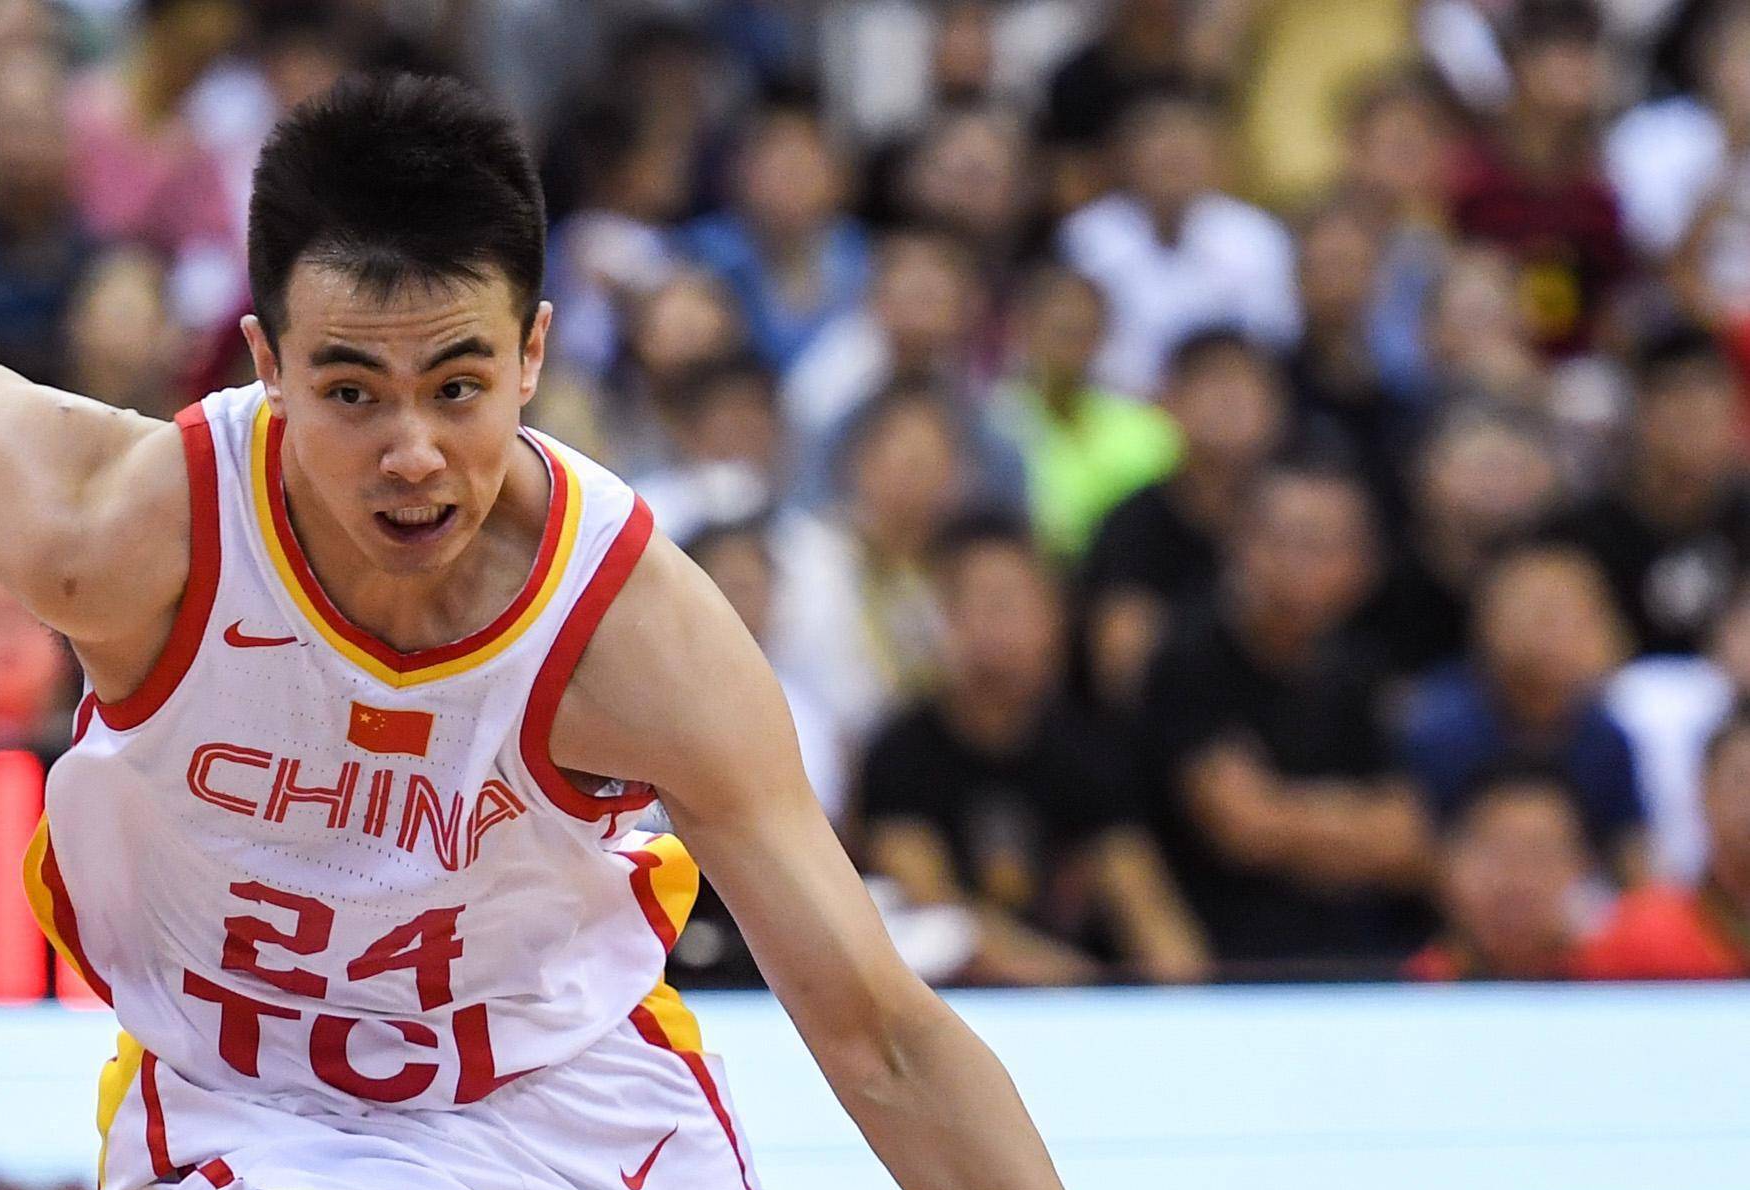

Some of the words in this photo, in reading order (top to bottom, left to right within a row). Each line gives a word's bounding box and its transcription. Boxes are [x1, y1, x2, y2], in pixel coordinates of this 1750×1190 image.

[186, 742, 527, 871] CHINA
[220, 880, 467, 1013] 24
[182, 968, 550, 1105] TCL
